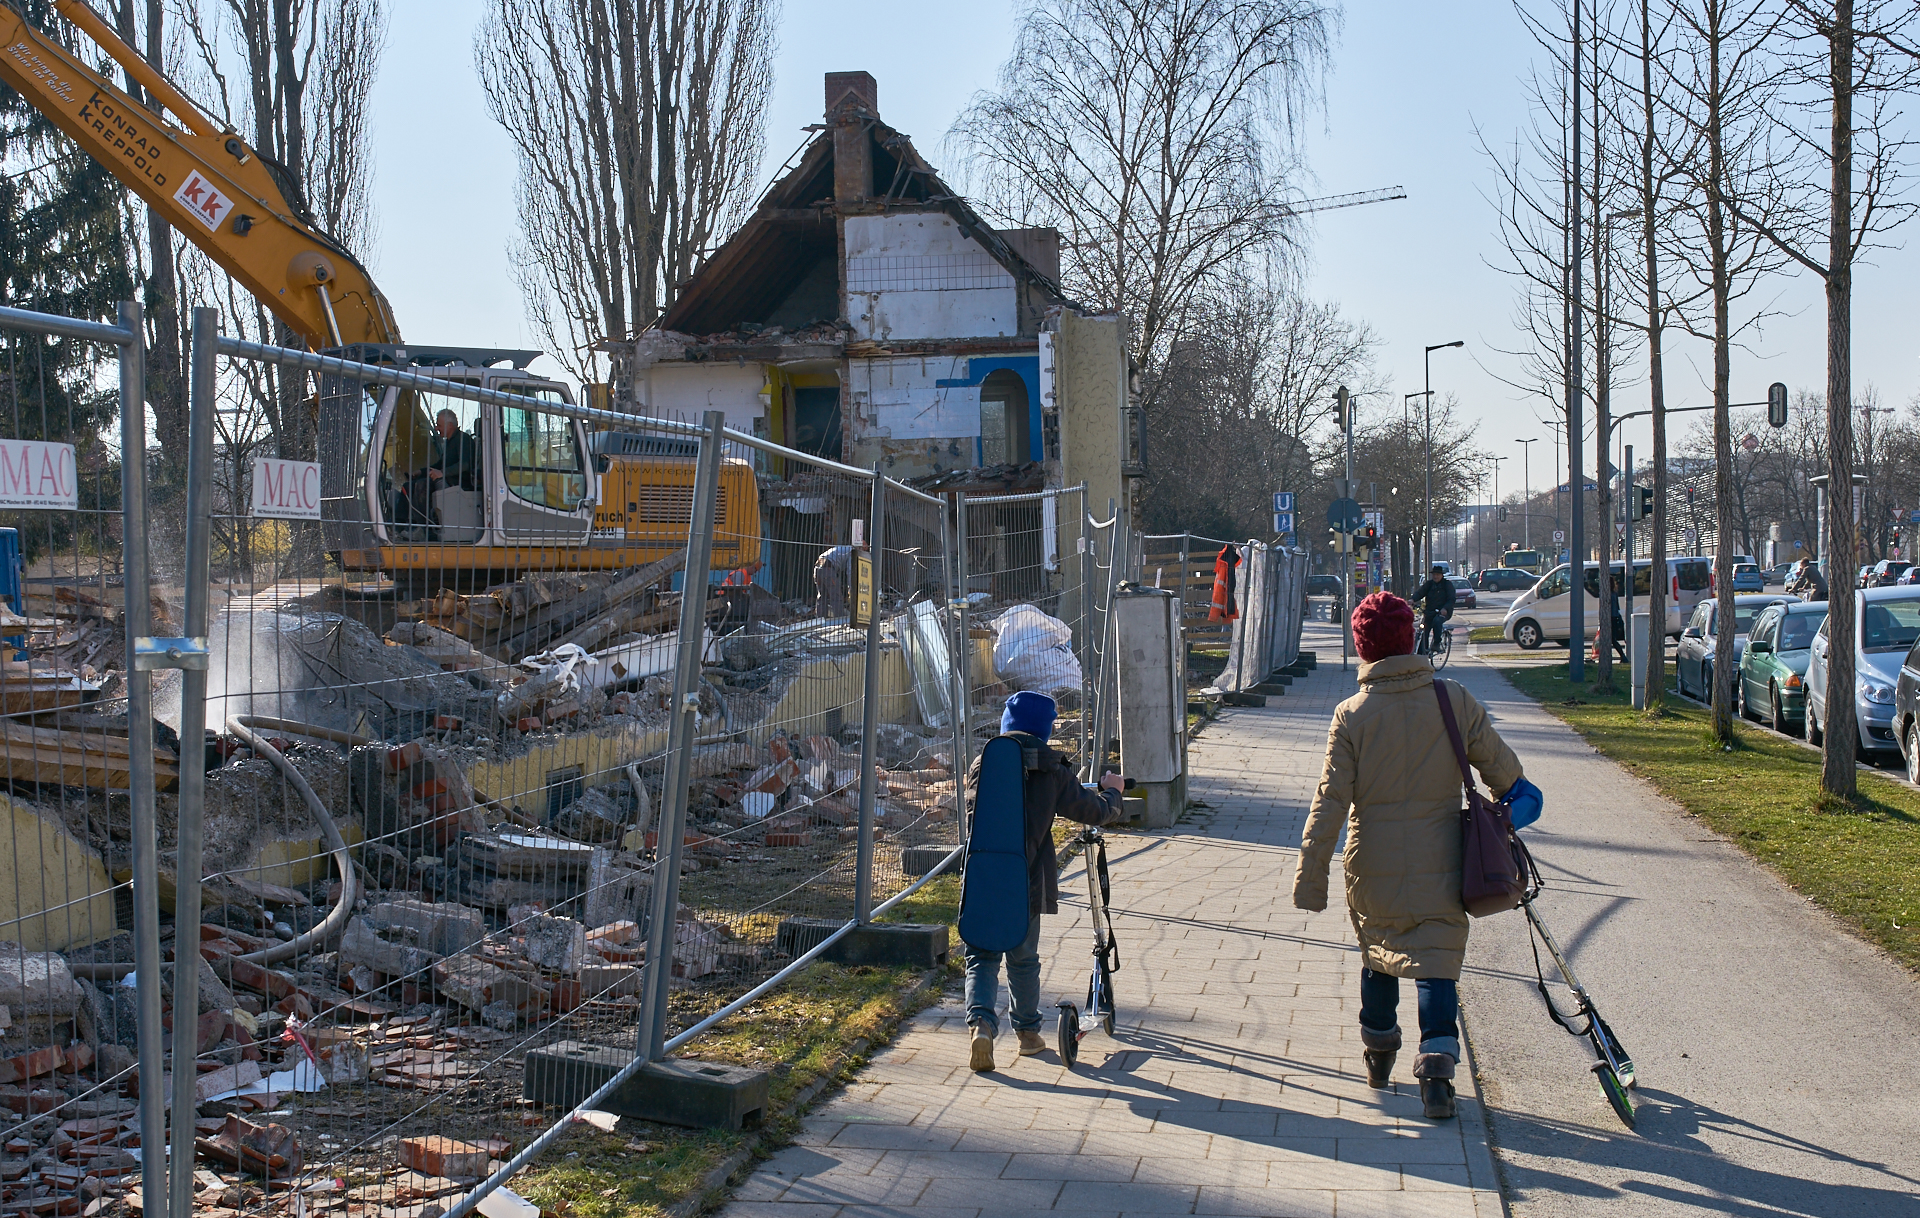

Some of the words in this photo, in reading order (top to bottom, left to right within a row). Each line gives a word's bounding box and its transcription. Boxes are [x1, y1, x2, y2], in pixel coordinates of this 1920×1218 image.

[7, 46, 32, 69] Steine
[32, 67, 45, 80] ins
[44, 79, 75, 104] Rollen!
[16, 42, 32, 56] Wir
[31, 55, 59, 81] bringen
[59, 81, 72, 92] die
[78, 104, 167, 187] KREPPOLD
[88, 91, 161, 160] KONRAD
[0, 444, 73, 497] MAC
[261, 462, 318, 510] MAC
[1277, 494, 1290, 511] U
